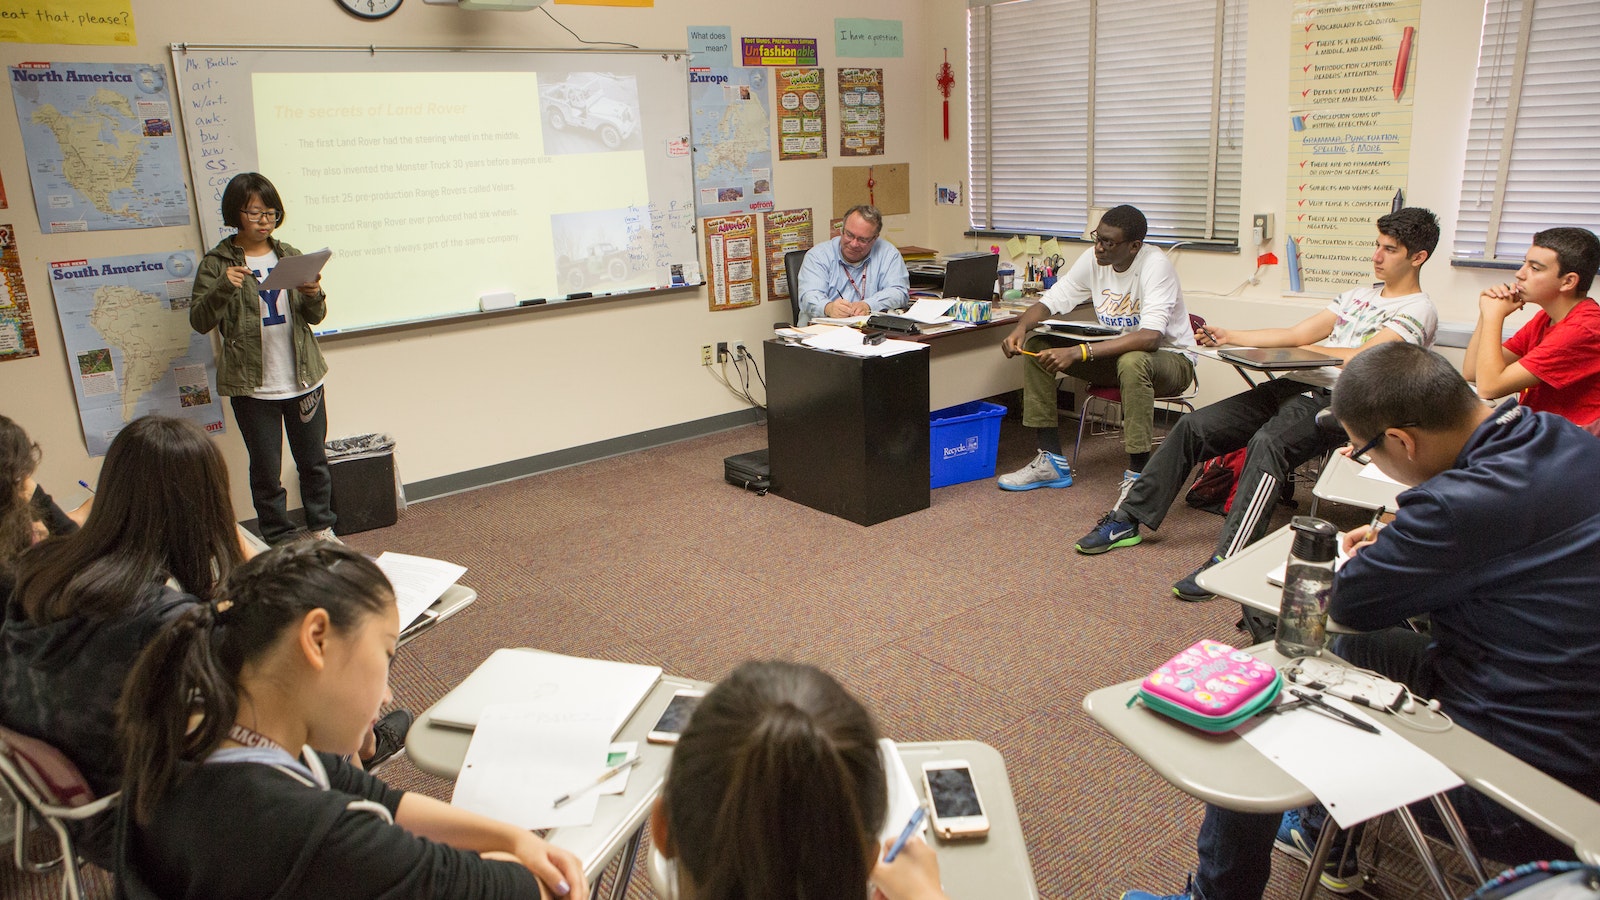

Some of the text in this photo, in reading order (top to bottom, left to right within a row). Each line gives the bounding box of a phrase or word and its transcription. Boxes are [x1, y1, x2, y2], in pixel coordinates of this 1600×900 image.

[79, 11, 129, 26] please?
[1316, 22, 1355, 31] VOCABULARY
[841, 31, 847, 40] I
[850, 30, 864, 40] have
[705, 44, 728, 52] mean?
[745, 45, 815, 56] Unfashionable
[1314, 60, 1392, 72] INTRODUCTION CAPTURES
[12, 70, 133, 83] North America
[689, 72, 729, 84] Europe
[1344, 70, 1379, 78] ATTENTION.
[1352, 86, 1383, 94] EXAMPLES
[274, 102, 466, 119] The secrets of Land Rover
[298, 139, 314, 149] The
[316, 138, 334, 149] first
[336, 137, 356, 148] Land
[358, 136, 381, 147] Rover
[383, 136, 399, 146] had
[399, 135, 413, 145] the
[415, 134, 447, 145] steering
[448, 133, 471, 143] wheel
[481, 132, 494, 142] the
[302, 167, 320, 178] They
[323, 166, 341, 177] also
[343, 164, 378, 176] invented
[380, 163, 393, 173] the
[396, 161, 428, 173] Monster
[430, 160, 451, 171] Truck
[453, 159, 463, 169] 30
[465, 159, 486, 170] years
[487, 157, 510, 168] before
[511, 156, 536, 167] anyone
[304, 195, 319, 206] The
[321, 194, 339, 204] first
[341, 193, 353, 203] 25
[355, 190, 413, 203] pre-production
[415, 188, 440, 199] Range
[441, 186, 467, 197] Rovers
[468, 184, 490, 195] called
[750, 201, 773, 211] upfront
[307, 223, 322, 233] The
[325, 222, 355, 232] second
[357, 219, 382, 231] Range
[384, 217, 407, 228] Rover
[408, 216, 425, 226] ever
[427, 213, 462, 225] produced
[464, 211, 478, 221] had
[479, 210, 490, 220] six
[338, 248, 361, 258] Rover
[364, 244, 391, 256] wasn't
[393, 242, 421, 253] always
[424, 240, 438, 252] part
[440, 239, 449, 249] of
[451, 238, 463, 248] the
[465, 237, 485, 247] same
[1306, 238, 1346, 246] PUNCTUATION
[1305, 253, 1350, 261] CAPITALIZATION
[53, 261, 164, 281] South America
[1305, 268, 1333, 276] SPELLING
[300, 390, 323, 415] NIKE
